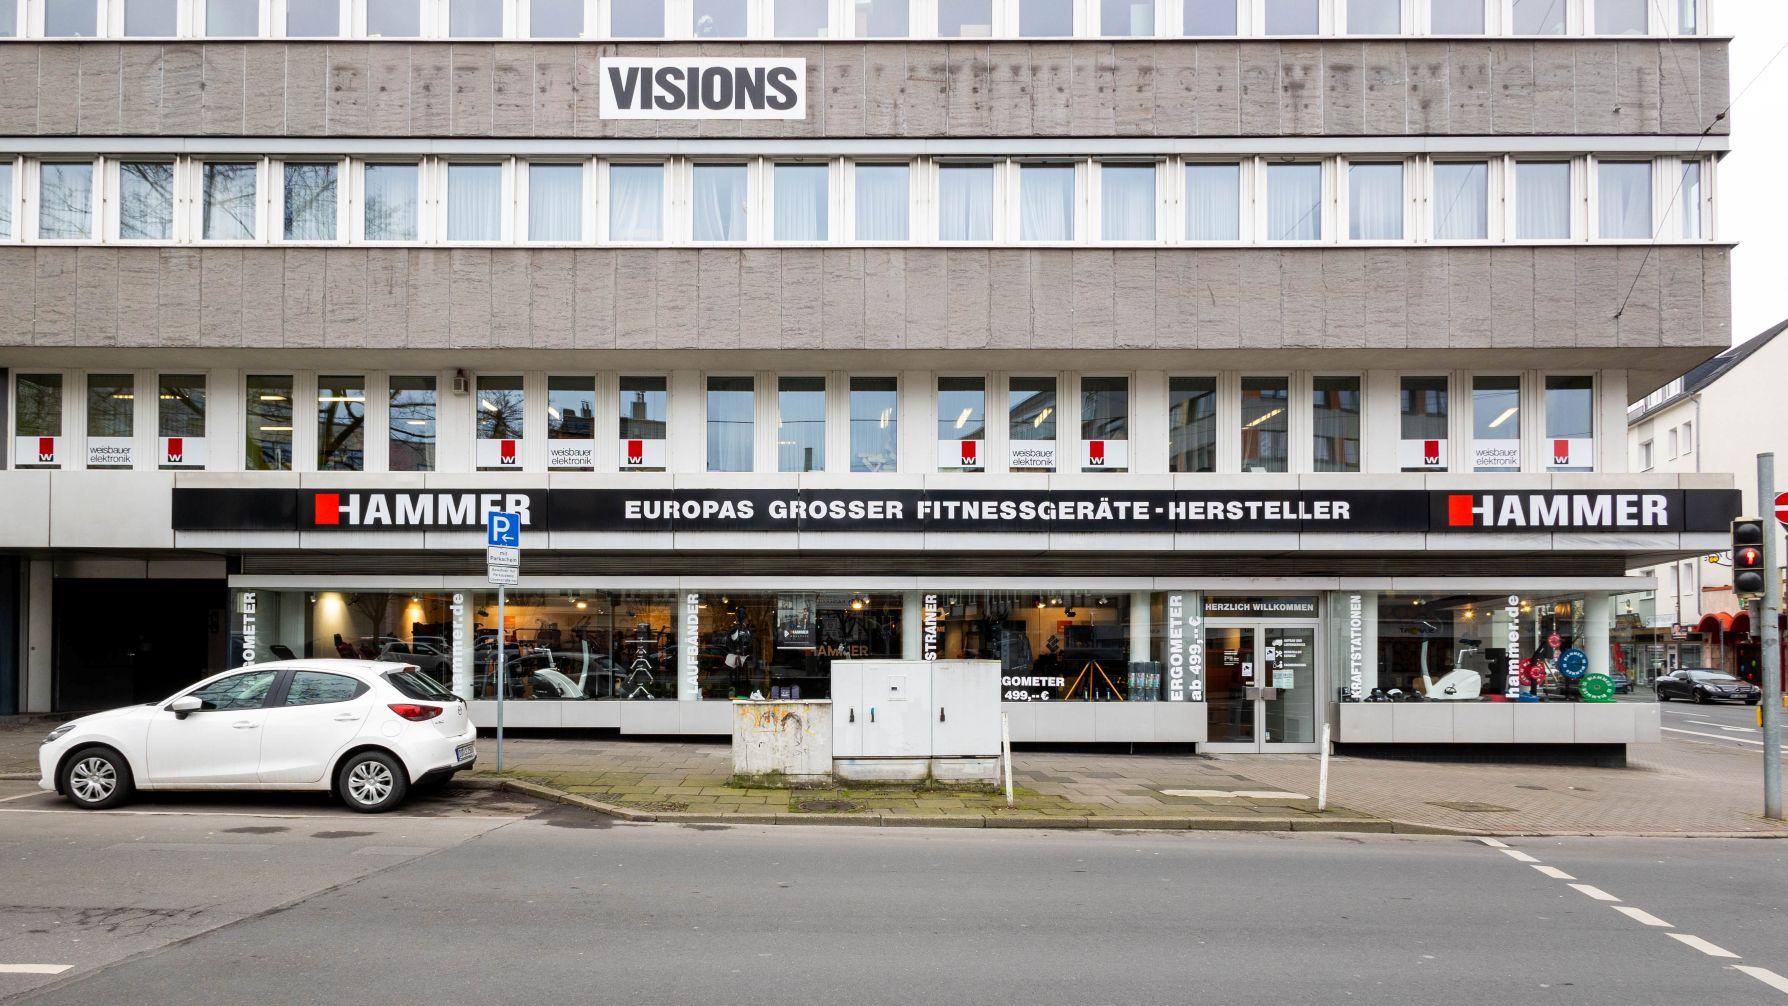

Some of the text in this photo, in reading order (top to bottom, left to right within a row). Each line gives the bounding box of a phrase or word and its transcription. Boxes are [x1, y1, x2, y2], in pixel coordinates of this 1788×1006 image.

[608, 66, 798, 111] VISIONS
[90, 446, 131, 454] weisbauer
[551, 448, 592, 456] weisbauer
[1012, 449, 1054, 457] weisbauer
[1476, 448, 1517, 456] weisbauer
[90, 454, 131, 463] elektronik
[551, 456, 592, 465] elektronik
[1012, 457, 1053, 466] elektronik
[1476, 456, 1517, 465] elektronik
[315, 493, 531, 525] HAMMER
[624, 500, 754, 519] EUROPAS
[768, 500, 903, 520] GROSSER
[1448, 494, 1668, 526] HAMMER
[493, 516, 511, 541] P
[1205, 603, 1314, 611] HERZLICH WILLKOMMEN
[1170, 595, 1183, 701] ERGOMETER
[1350, 595, 1362, 698] KRAFTSTATIONEN
[1505, 595, 1519, 698] hammer.de
[1000, 676, 1065, 687] GOMETER
[1189, 680, 1202, 700] ab
